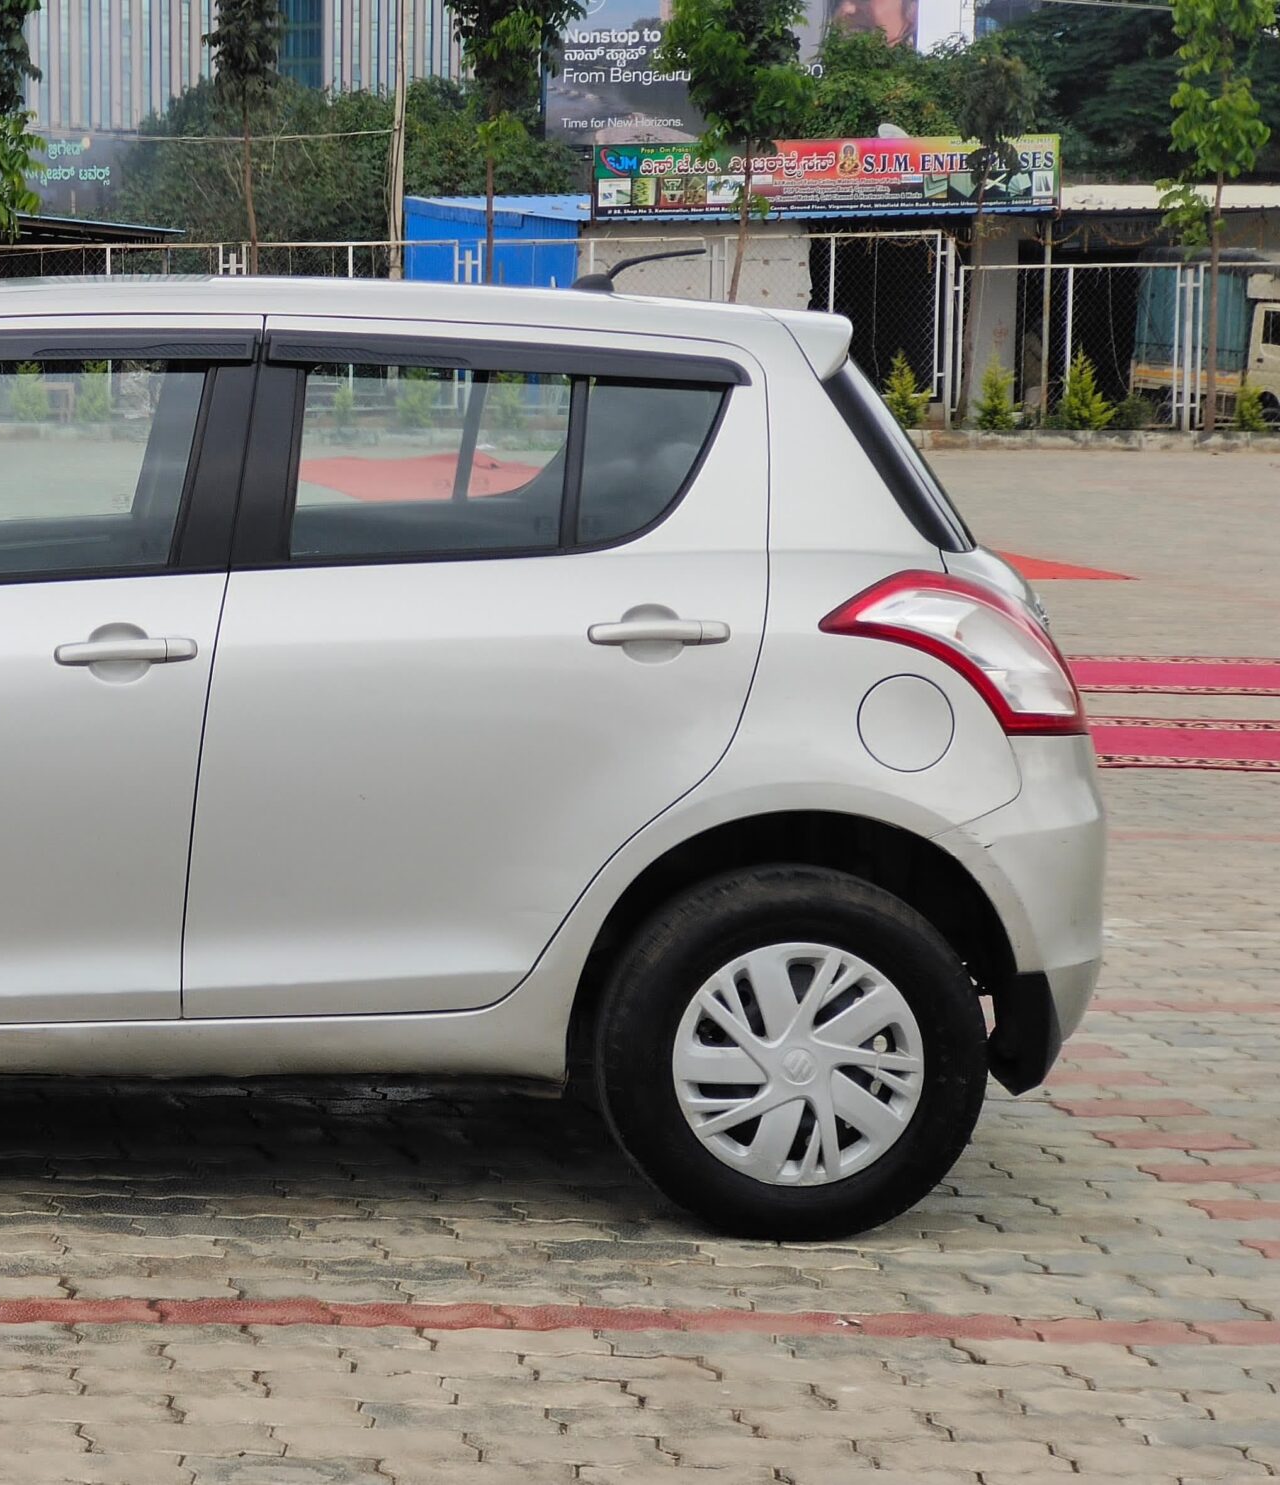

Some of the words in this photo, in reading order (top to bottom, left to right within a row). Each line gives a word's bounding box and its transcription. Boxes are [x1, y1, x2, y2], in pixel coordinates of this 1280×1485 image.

[564, 29, 639, 46] Nonstop
[643, 28, 661, 43] to
[563, 68, 605, 84] From
[561, 117, 588, 129] Time
[590, 117, 605, 128] for
[607, 117, 633, 128] New
[635, 116, 684, 127] Horizons.
[862, 154, 914, 173] S.J.M.
